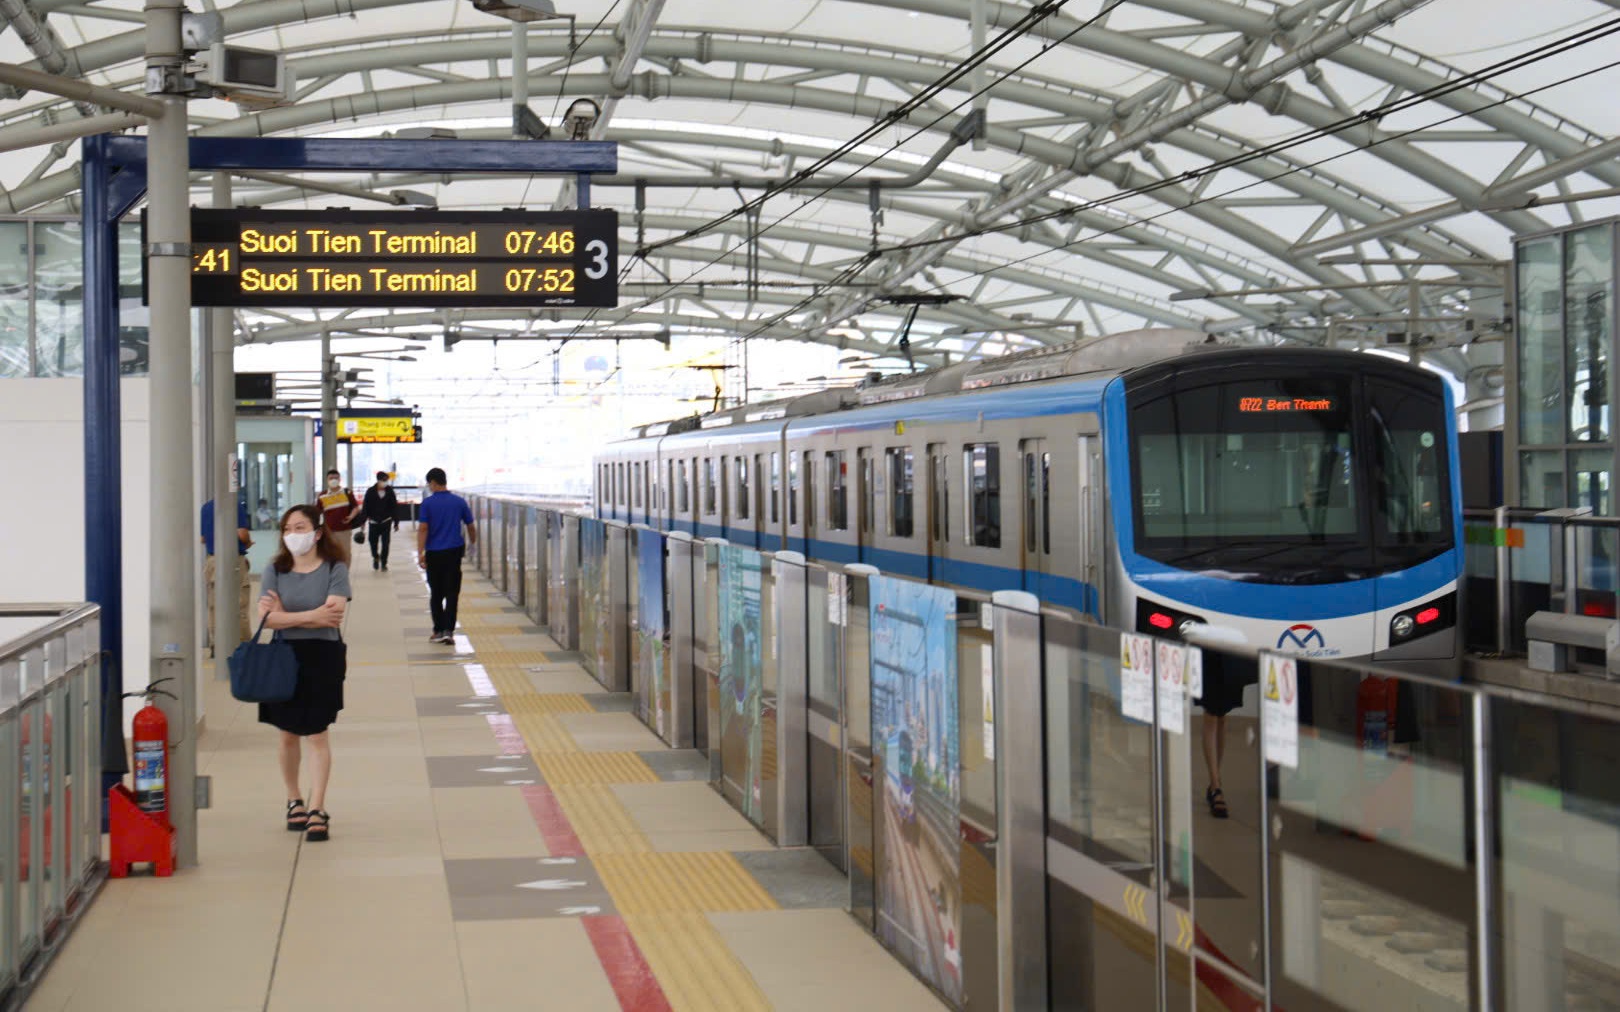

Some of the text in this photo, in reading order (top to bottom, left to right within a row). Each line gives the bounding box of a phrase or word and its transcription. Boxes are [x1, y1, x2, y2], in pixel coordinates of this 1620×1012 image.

[240, 229, 575, 254] Suoi Tien Terminal 07:46
[584, 239, 608, 281] 3
[240, 268, 575, 292] Suoi Tien Terminal 07:52
[1266, 399, 1291, 411] Ben
[1294, 399, 1331, 411] Thanh
